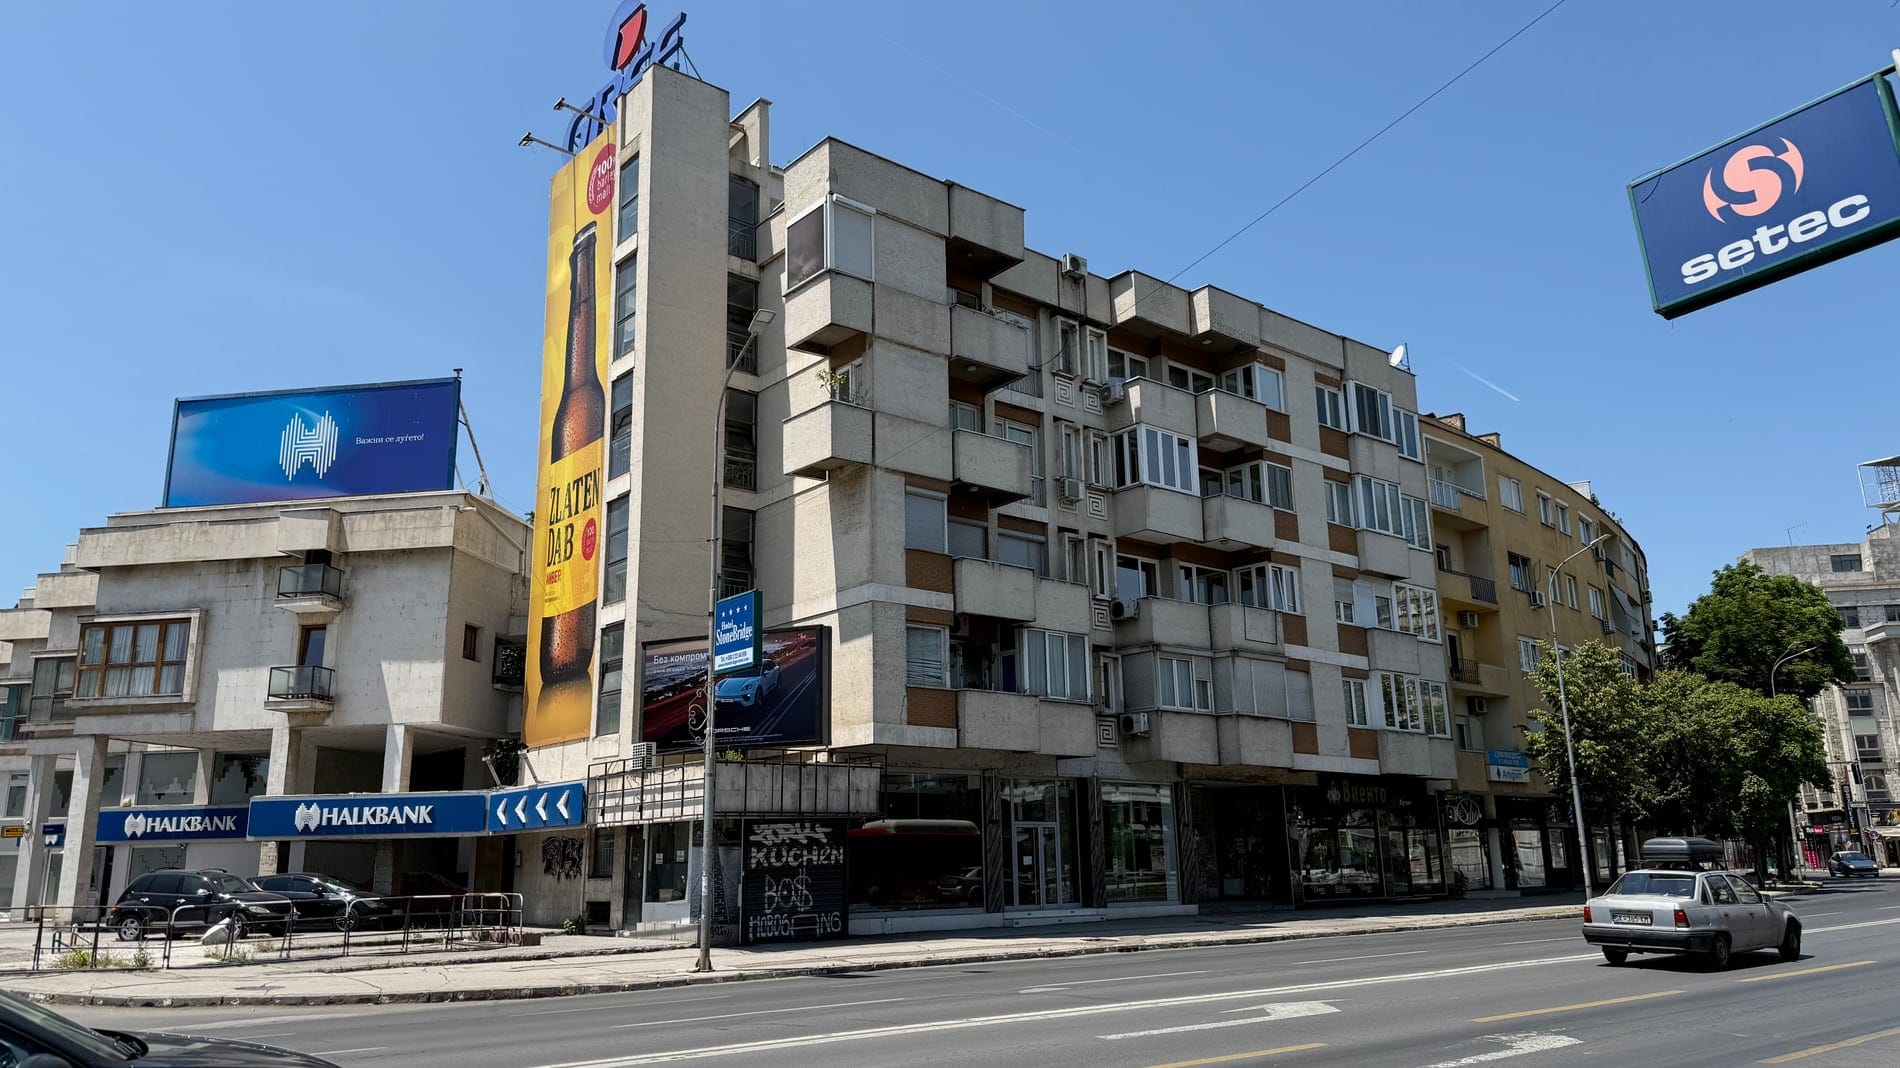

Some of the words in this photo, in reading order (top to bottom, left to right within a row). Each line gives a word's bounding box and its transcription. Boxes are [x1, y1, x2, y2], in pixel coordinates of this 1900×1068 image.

[1680, 193, 1872, 285] setec
[355, 437, 384, 445] Важни
[395, 433, 425, 444] луѓето!
[549, 467, 600, 526] ZLATEN
[547, 522, 574, 567] DAB
[721, 619, 734, 631] Hotel
[653, 655, 668, 664] Без
[670, 652, 709, 663] компром
[1342, 781, 1387, 802] Виенто
[146, 815, 237, 833] HALKBANK
[321, 805, 433, 826] HALKBANK
